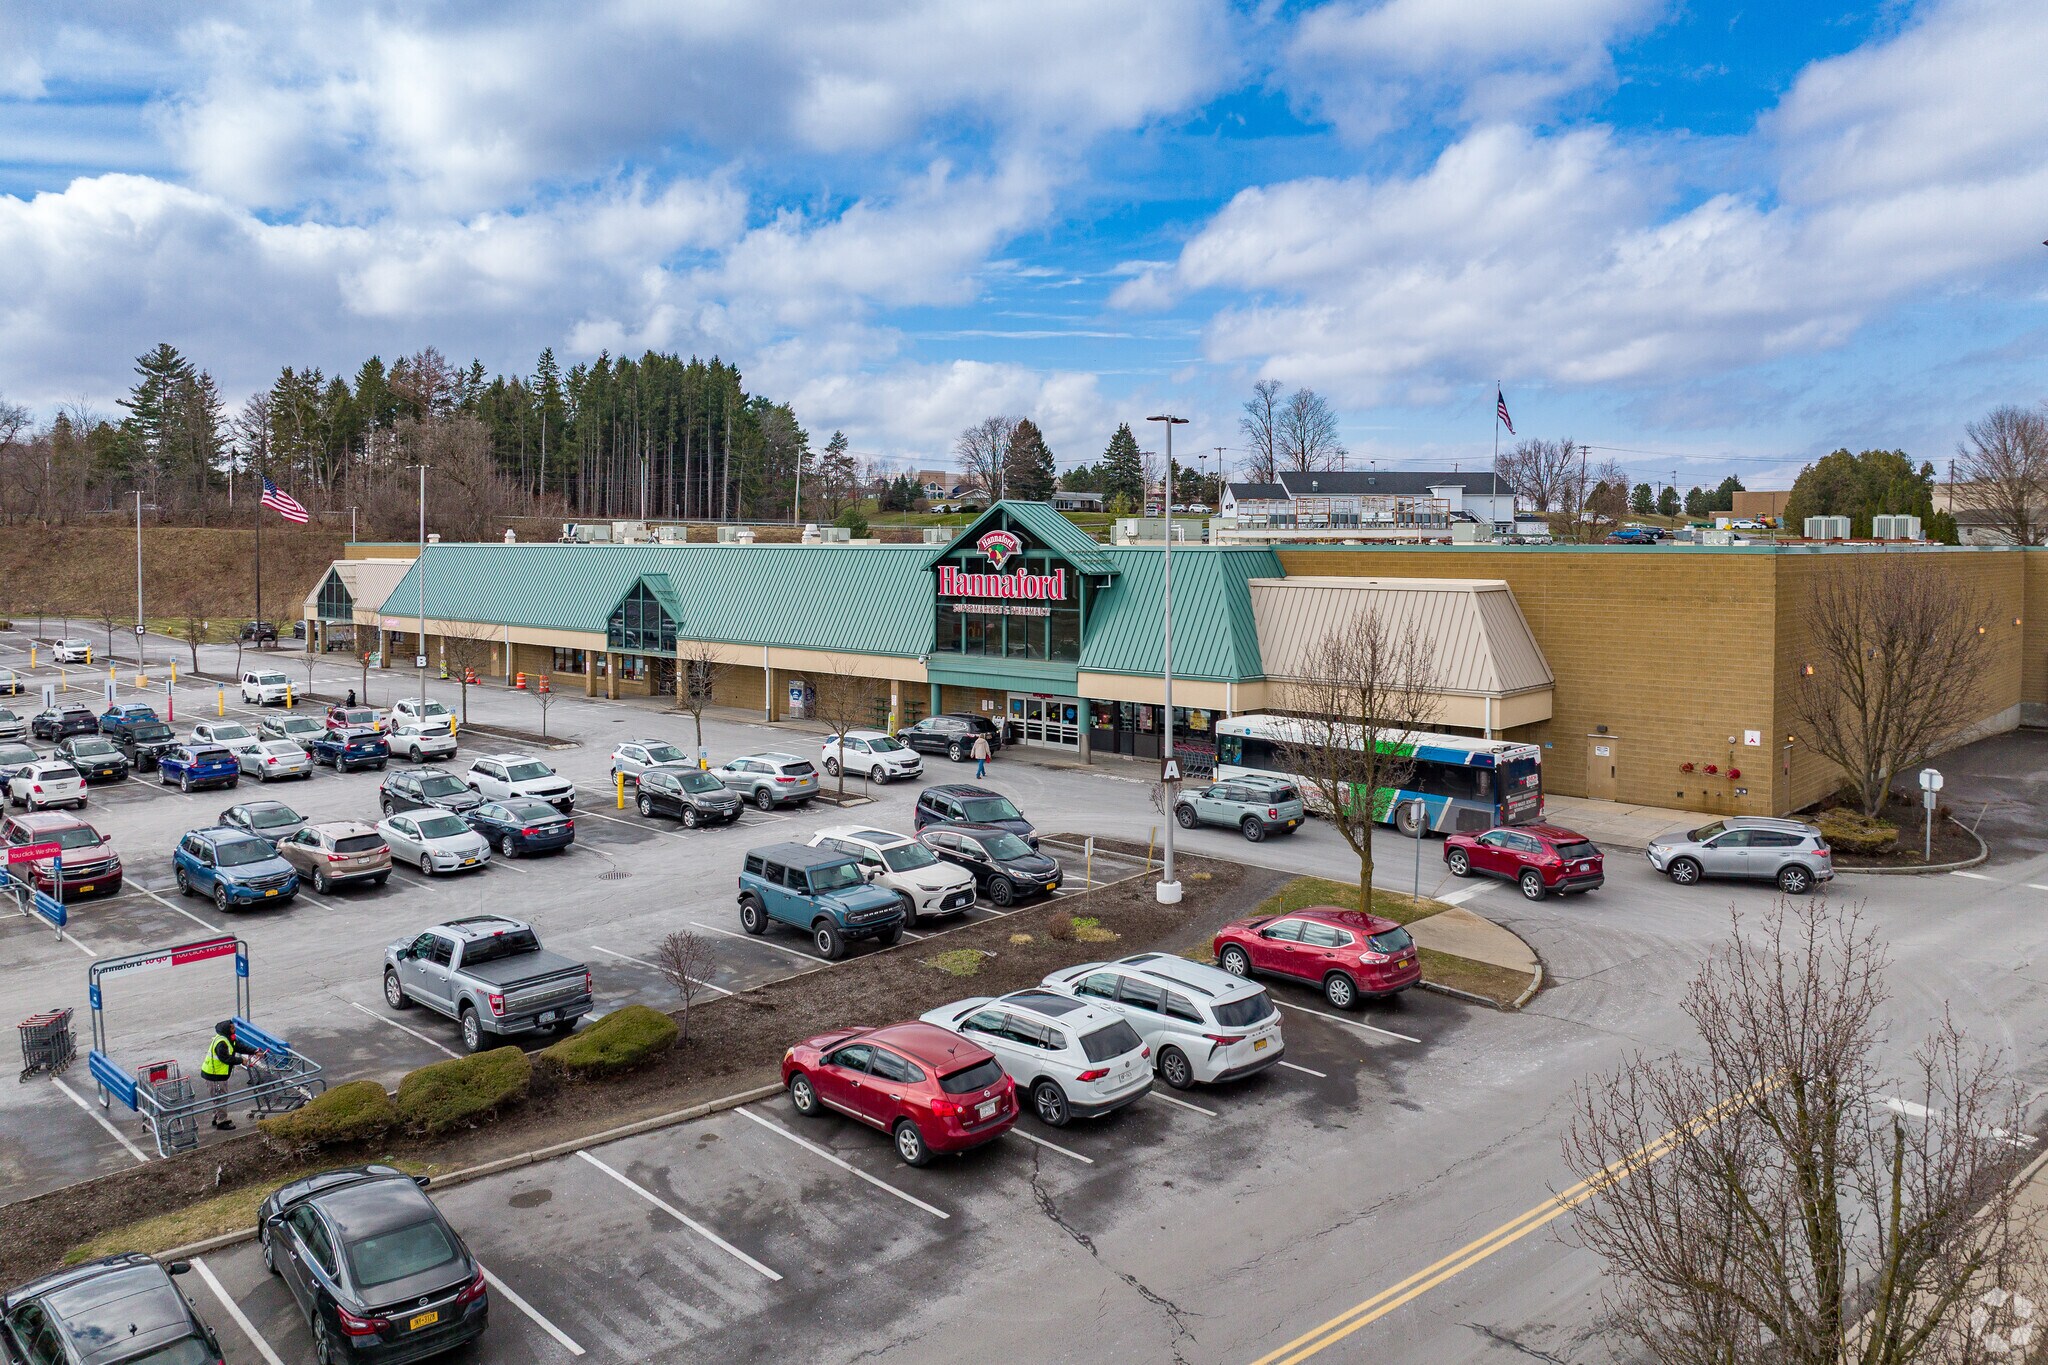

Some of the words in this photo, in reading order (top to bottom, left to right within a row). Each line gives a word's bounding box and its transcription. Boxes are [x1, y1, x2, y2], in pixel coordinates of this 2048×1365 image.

[981, 535, 1015, 548] Hannaford
[938, 565, 1067, 600] Hannaford
[952, 604, 1002, 614] SUPERMARKET
[1003, 605, 1010, 616] &
[1010, 606, 1051, 617] PHARMACY
[136, 625, 144, 634] C
[416, 655, 427, 667] B
[1163, 760, 1180, 779] A
